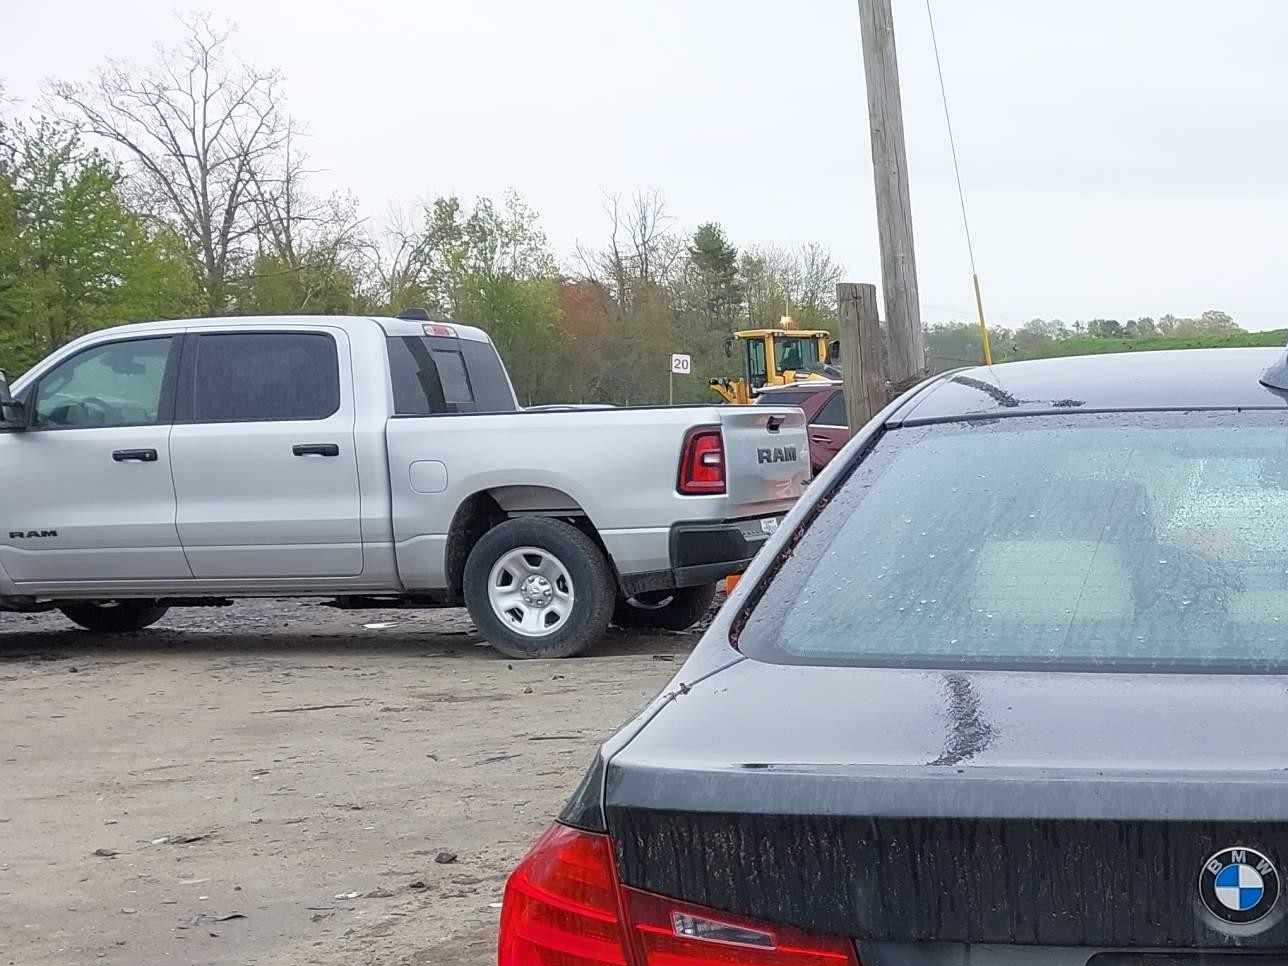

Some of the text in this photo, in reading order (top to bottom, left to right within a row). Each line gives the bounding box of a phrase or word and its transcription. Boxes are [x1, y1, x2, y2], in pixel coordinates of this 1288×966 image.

[674, 358, 689, 370] 20
[757, 447, 797, 464] RAM
[9, 530, 58, 539] RAM
[1206, 850, 1273, 876] BMW
